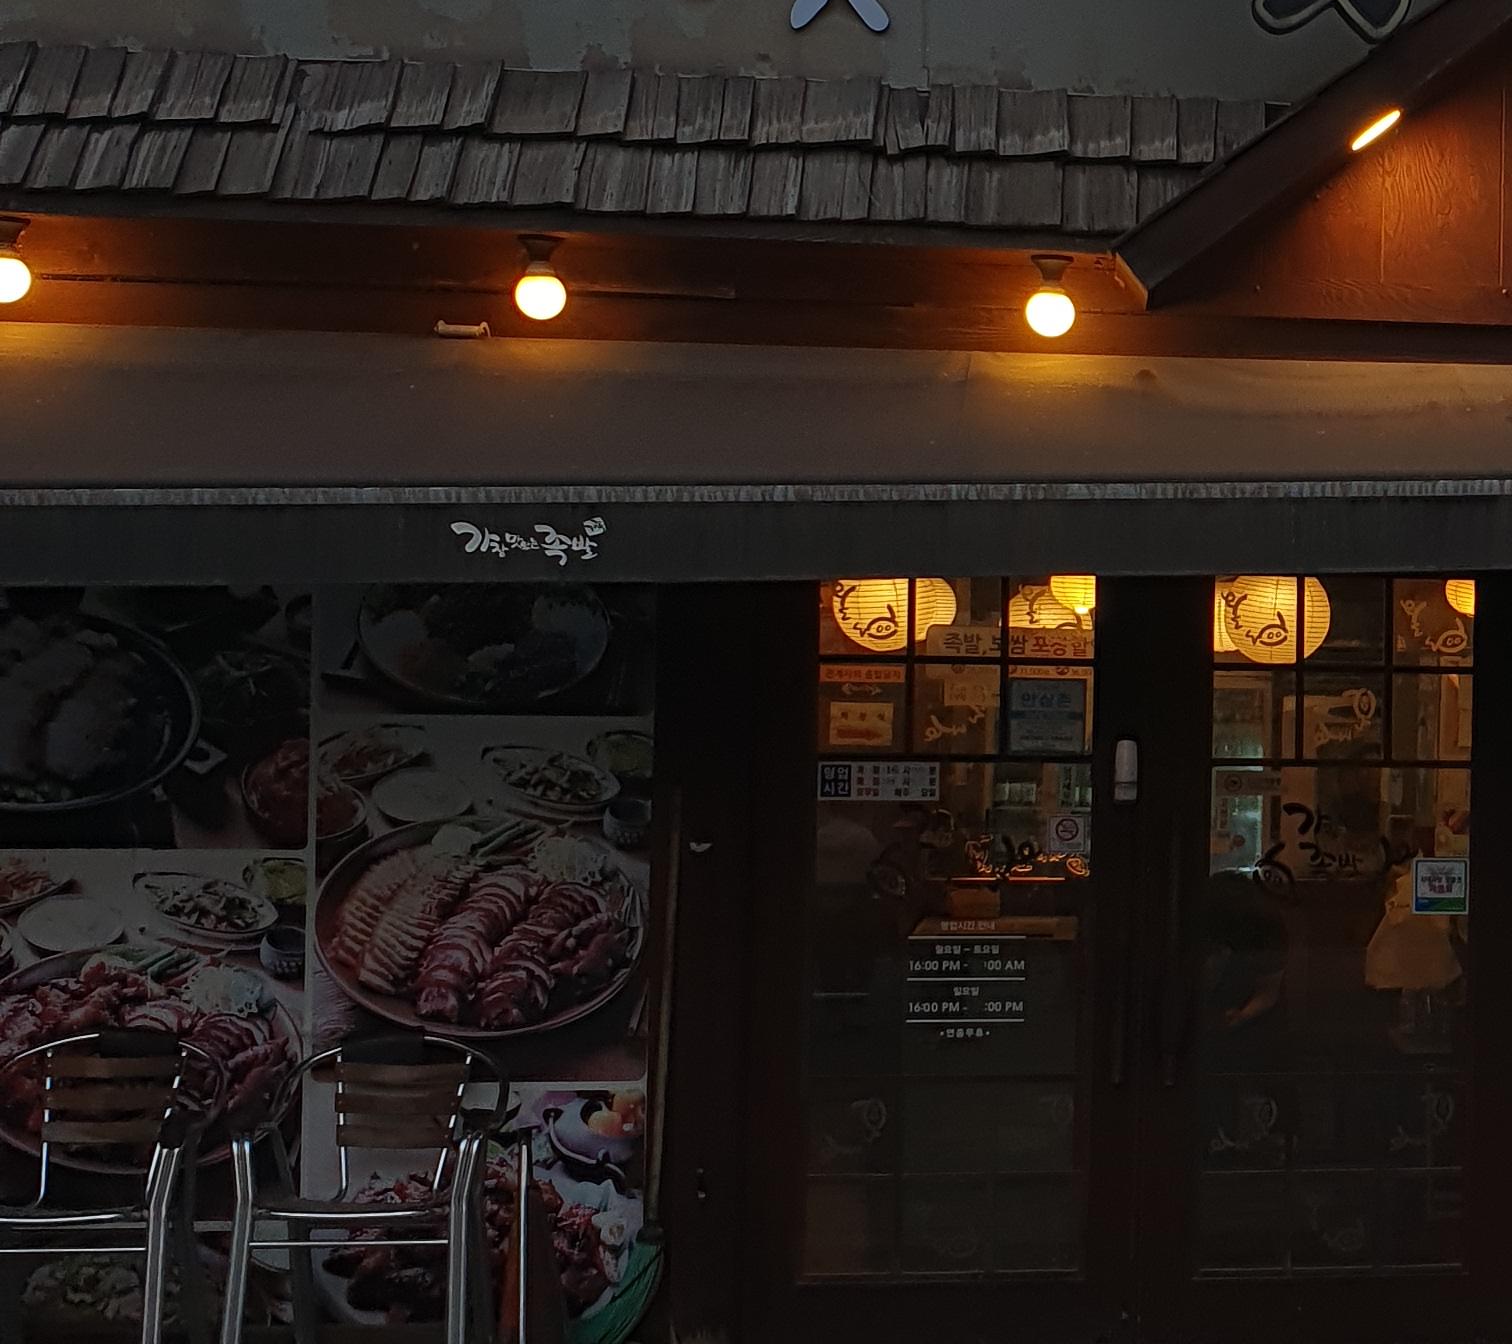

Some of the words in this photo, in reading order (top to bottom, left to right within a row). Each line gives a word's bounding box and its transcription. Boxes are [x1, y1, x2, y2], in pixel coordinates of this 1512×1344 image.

[450, 521, 509, 558] 가장
[534, 523, 599, 567] 족발
[909, 959, 939, 972] 16:00
[942, 960, 962, 971] PM
[1004, 959, 1025, 971] AM
[908, 1001, 938, 1014] 16:00
[941, 1002, 961, 1013] PM
[1004, 1001, 1024, 1012] PM
